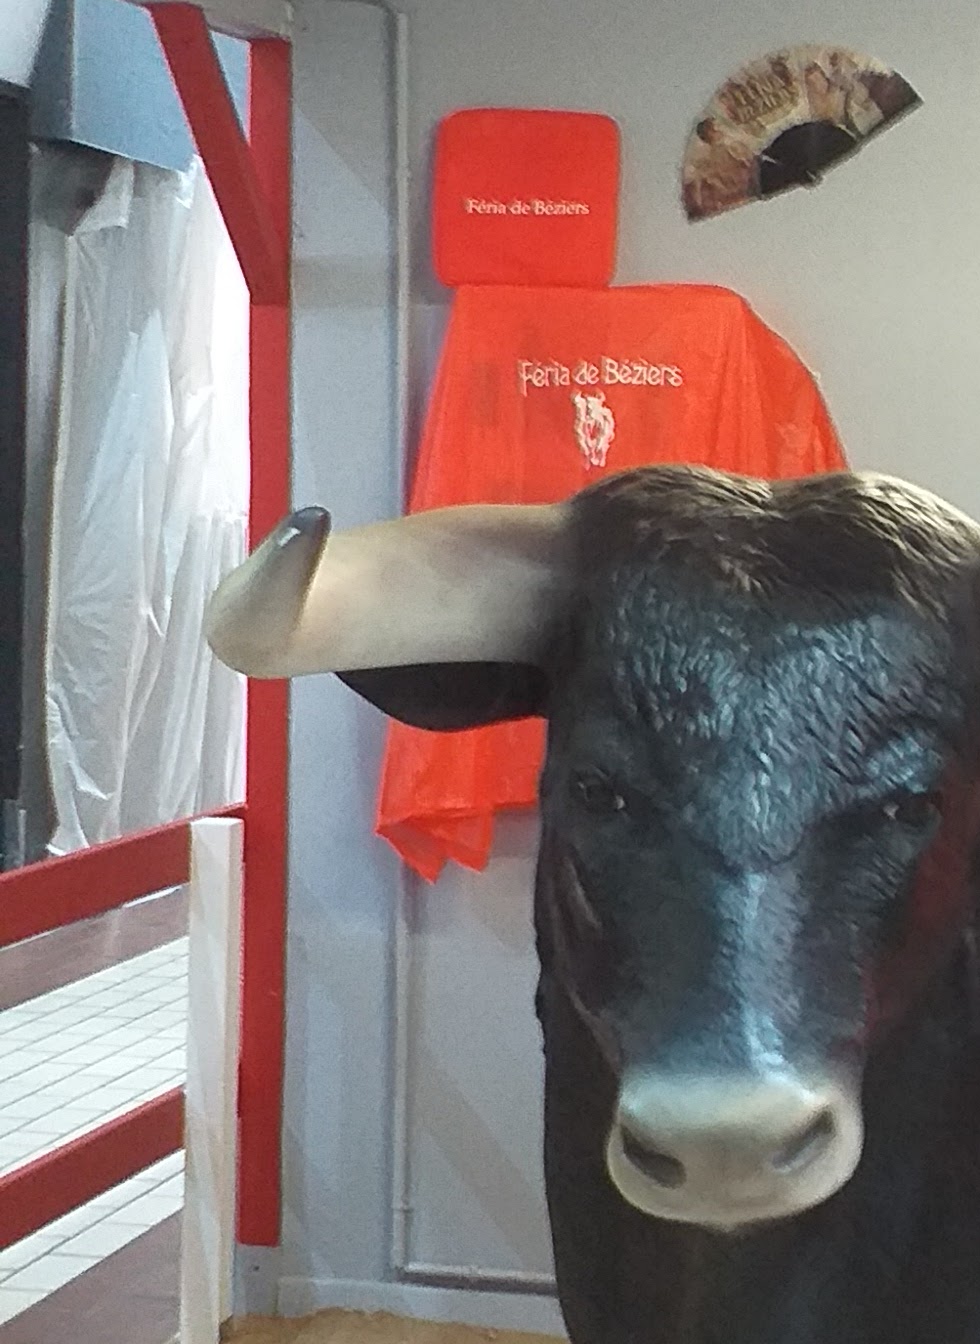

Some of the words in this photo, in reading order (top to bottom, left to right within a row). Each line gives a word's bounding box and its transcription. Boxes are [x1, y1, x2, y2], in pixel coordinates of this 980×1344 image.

[509, 199, 530, 215] de
[519, 359, 571, 397] Féria
[573, 361, 600, 386] de
[603, 356, 684, 388] Béziers
